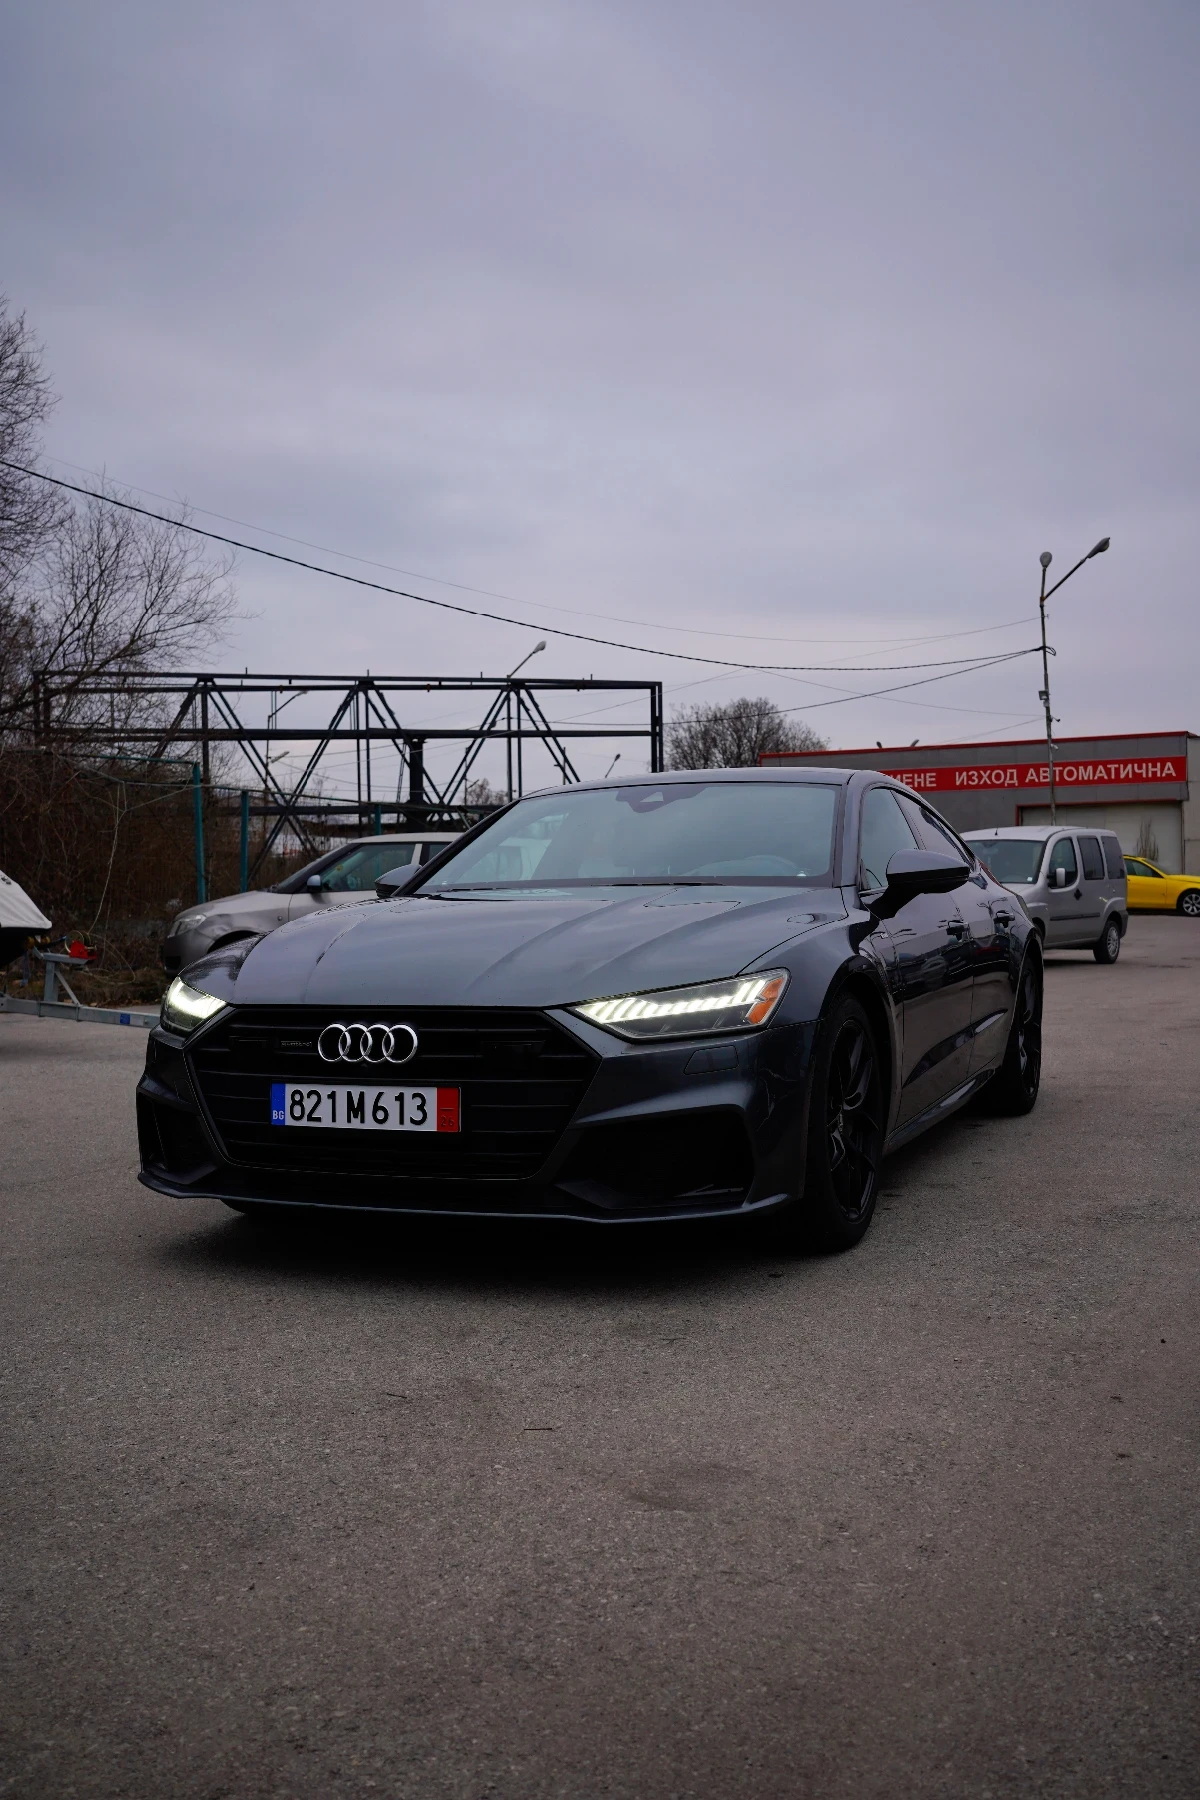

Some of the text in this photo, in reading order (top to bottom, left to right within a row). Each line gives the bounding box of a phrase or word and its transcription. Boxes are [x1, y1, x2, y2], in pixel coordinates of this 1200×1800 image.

[955, 769, 1018, 787] ИЗХОД
[1025, 761, 1177, 783] АВТОМАТИЧНА
[272, 1110, 285, 1120] BG
[289, 1089, 428, 1126] 821M613
